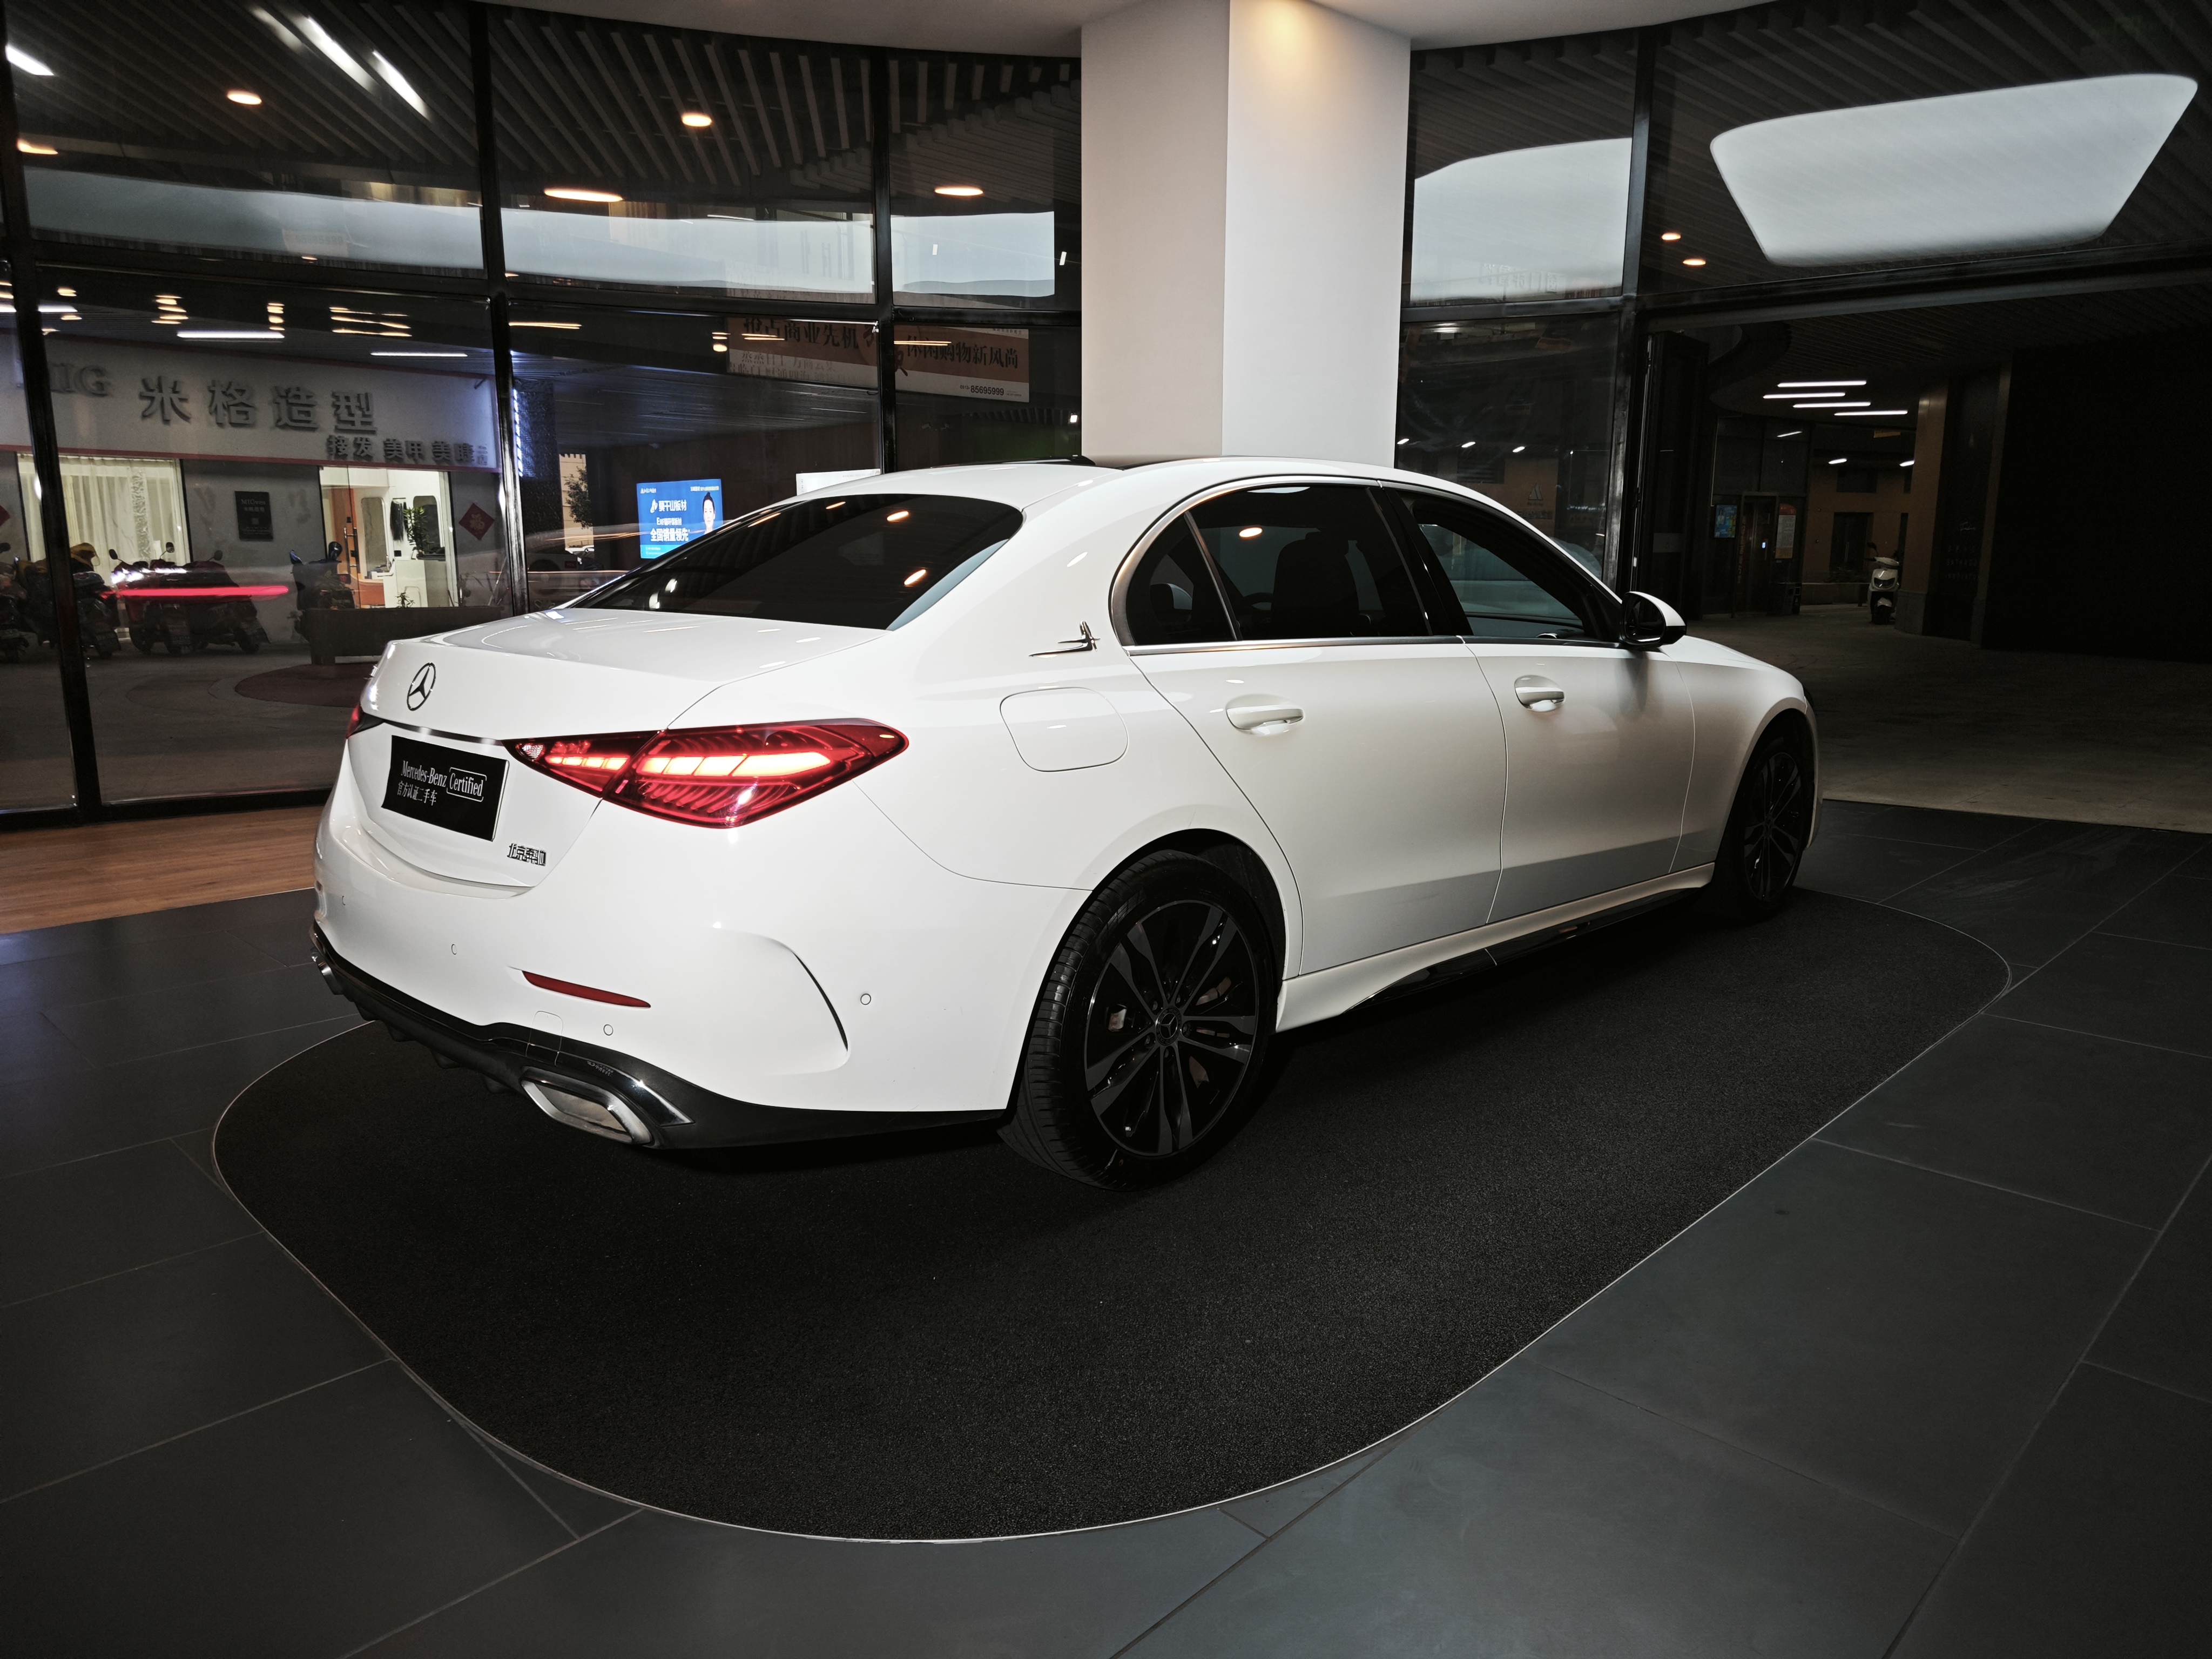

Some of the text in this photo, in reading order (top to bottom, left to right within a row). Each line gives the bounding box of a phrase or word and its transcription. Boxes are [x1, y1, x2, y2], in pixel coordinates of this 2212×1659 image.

[139, 376, 377, 435] 米格造型
[383, 438, 423, 461] 美甲
[658, 500, 687, 511] 莫干山板材
[650, 528, 689, 542] 全国销量领先
[401, 760, 483, 797] Mercedes-Benz Certified
[397, 780, 437, 806] 官方认证二手车
[507, 842, 547, 866] 北京奔驰
